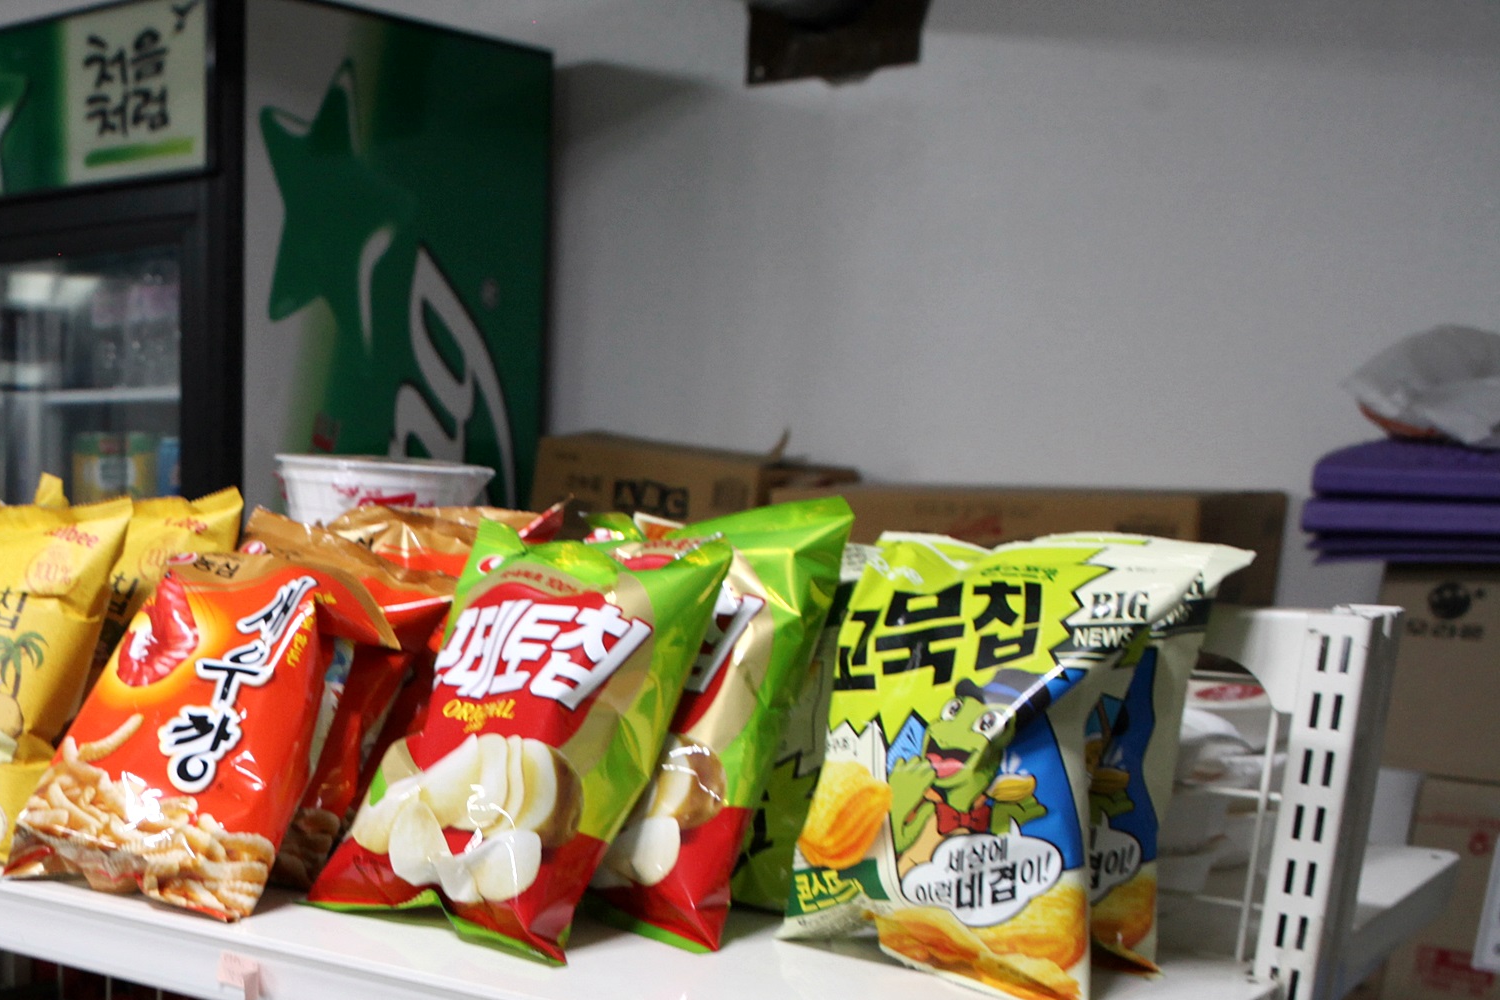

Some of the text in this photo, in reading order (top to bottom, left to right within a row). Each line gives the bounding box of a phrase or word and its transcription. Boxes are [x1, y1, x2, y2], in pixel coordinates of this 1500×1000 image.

[83, 26, 169, 88] 처음
[86, 89, 170, 138] 처럼
[1091, 589, 1149, 620] BIG
[1072, 627, 1135, 648] NEWS
[157, 574, 319, 794] 새우깡
[949, 836, 1008, 873] 세상에
